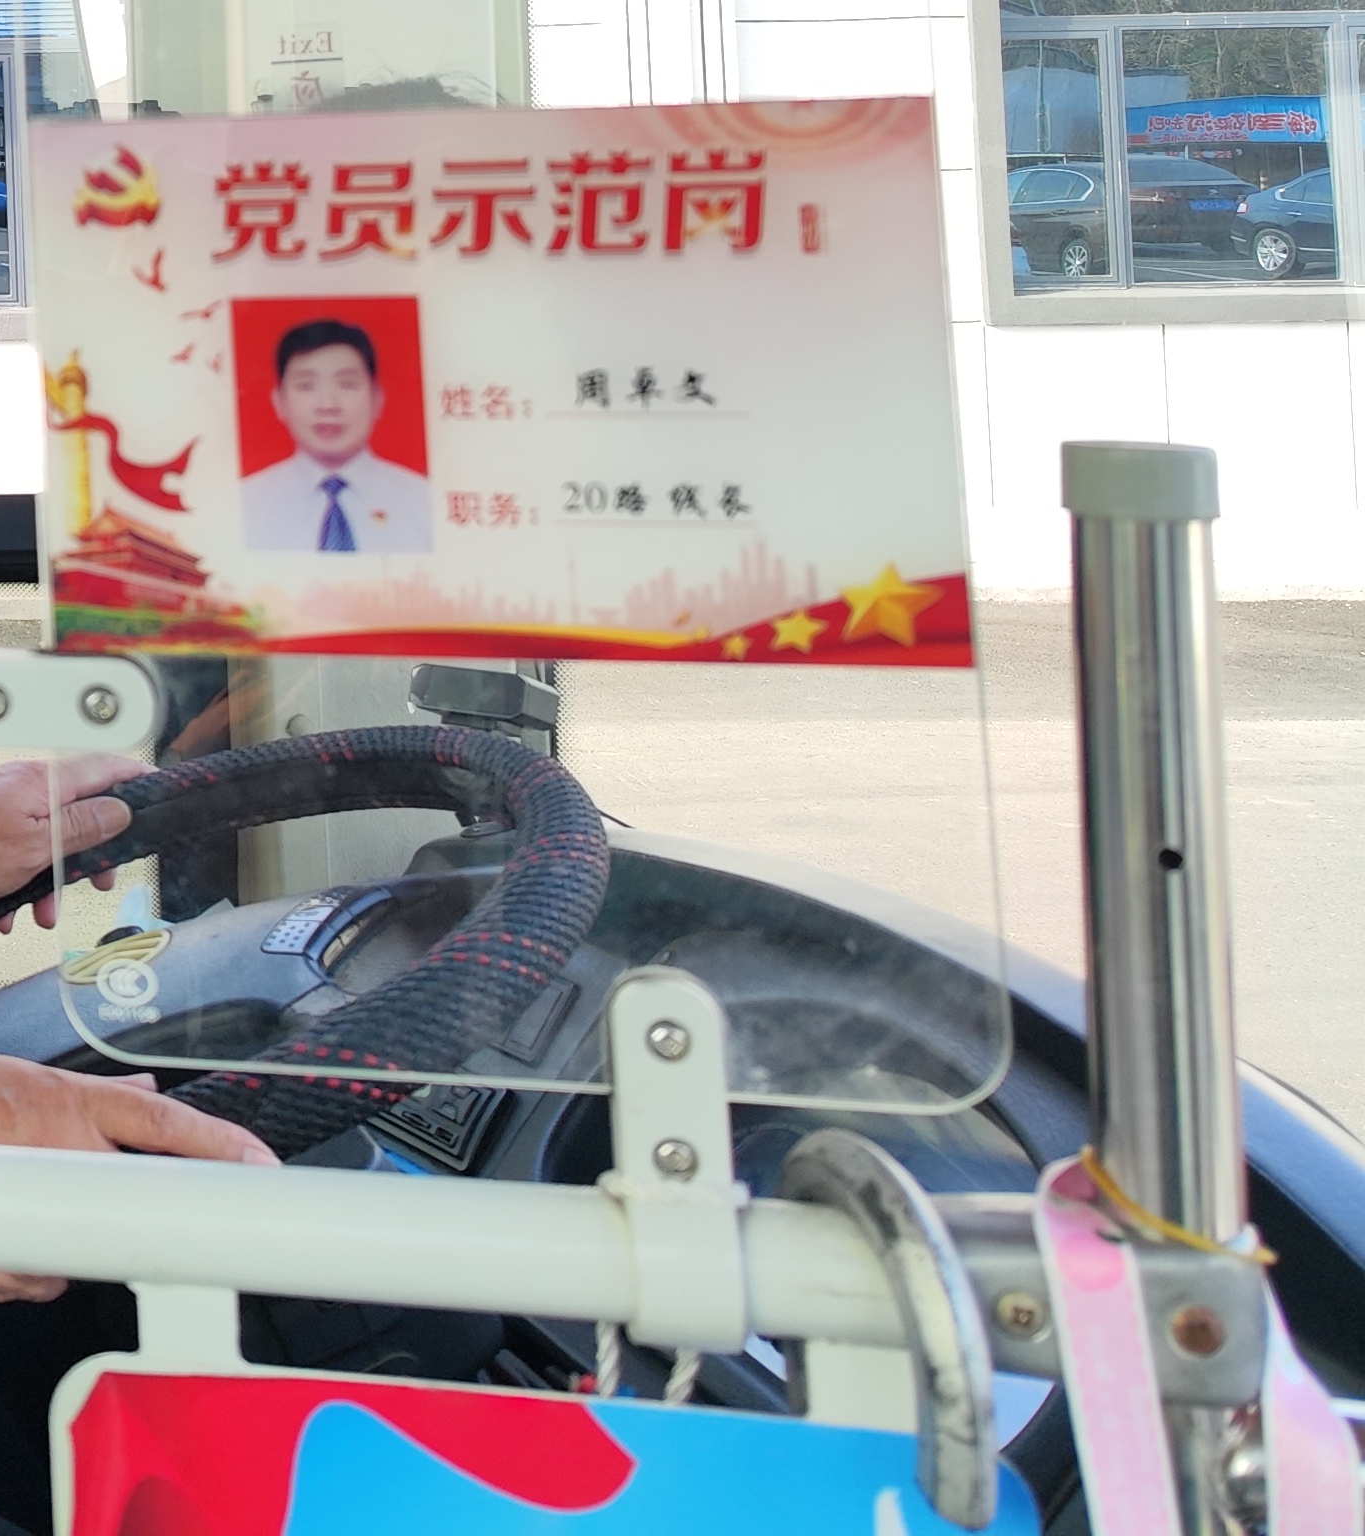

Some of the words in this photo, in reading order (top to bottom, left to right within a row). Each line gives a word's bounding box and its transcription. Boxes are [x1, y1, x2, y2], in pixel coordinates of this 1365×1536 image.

[211, 148, 767, 262] 党员示范岗
